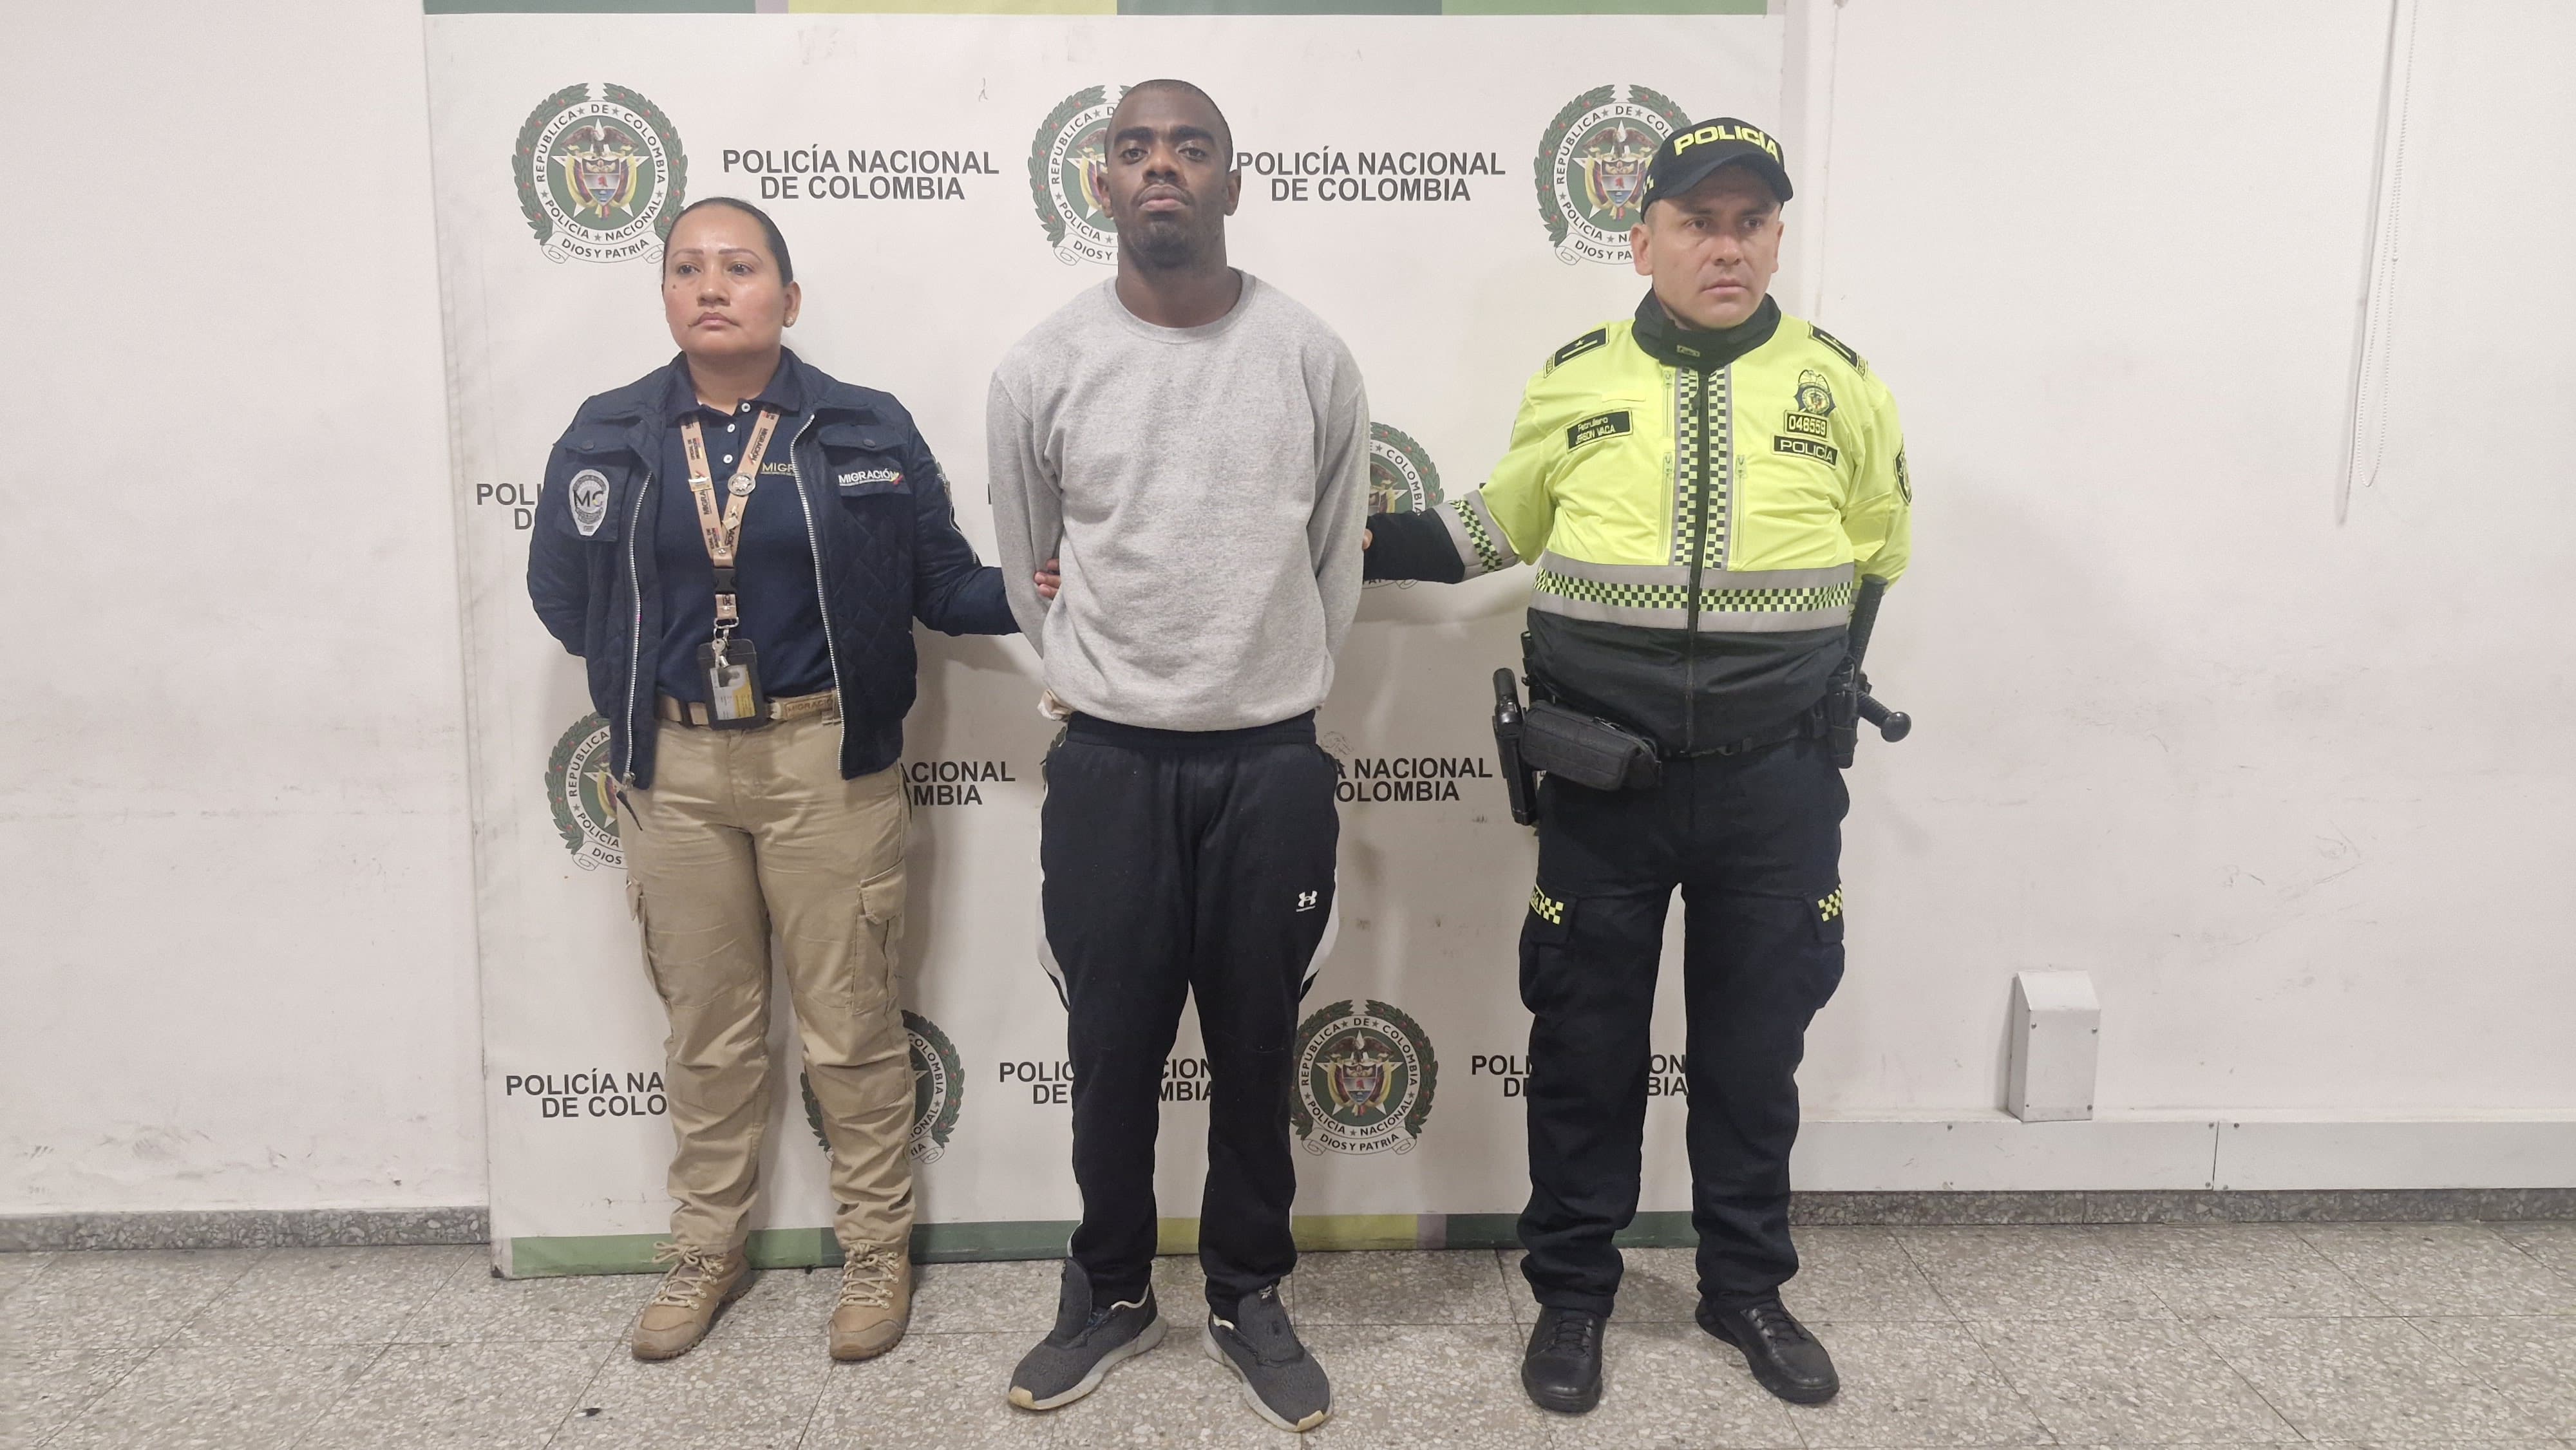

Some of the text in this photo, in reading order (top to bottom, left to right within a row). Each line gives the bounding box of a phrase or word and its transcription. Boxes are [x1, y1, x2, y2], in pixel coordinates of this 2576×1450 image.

[1615, 106, 1632, 115] DE
[591, 104, 609, 114] DE
[624, 113, 665, 184] COLOMBIA
[723, 144, 999, 174] POLICÍA NACIONAL
[1236, 146, 1506, 176] POLICÍA NACIONAL
[761, 176, 965, 200] DE COLOMBIA
[1271, 178, 1471, 202] DE COLOMBIA
[605, 197, 661, 241] NACIONAL
[562, 238, 594, 258] DIOS
[606, 239, 649, 258] PATRIA
[1074, 241, 1103, 259] DIOS
[1575, 240, 1604, 259] DIOS
[838, 469, 898, 484] MIGRACIÓN
[574, 490, 604, 507] MC
[1354, 758, 1493, 778] NACIONAL
[592, 847, 622, 864] DIOS
[1354, 1018, 1370, 1026] DE
[1383, 1025, 1417, 1086] COLOMBIA
[506, 1068, 619, 1095] POLICÍA
[1033, 1084, 1068, 1104] DE
[542, 1097, 579, 1118] DE
[1361, 1099, 1412, 1136] NACIONAL
[1320, 1133, 1347, 1150] DIOS
[1360, 1133, 1399, 1151] PATRIA
